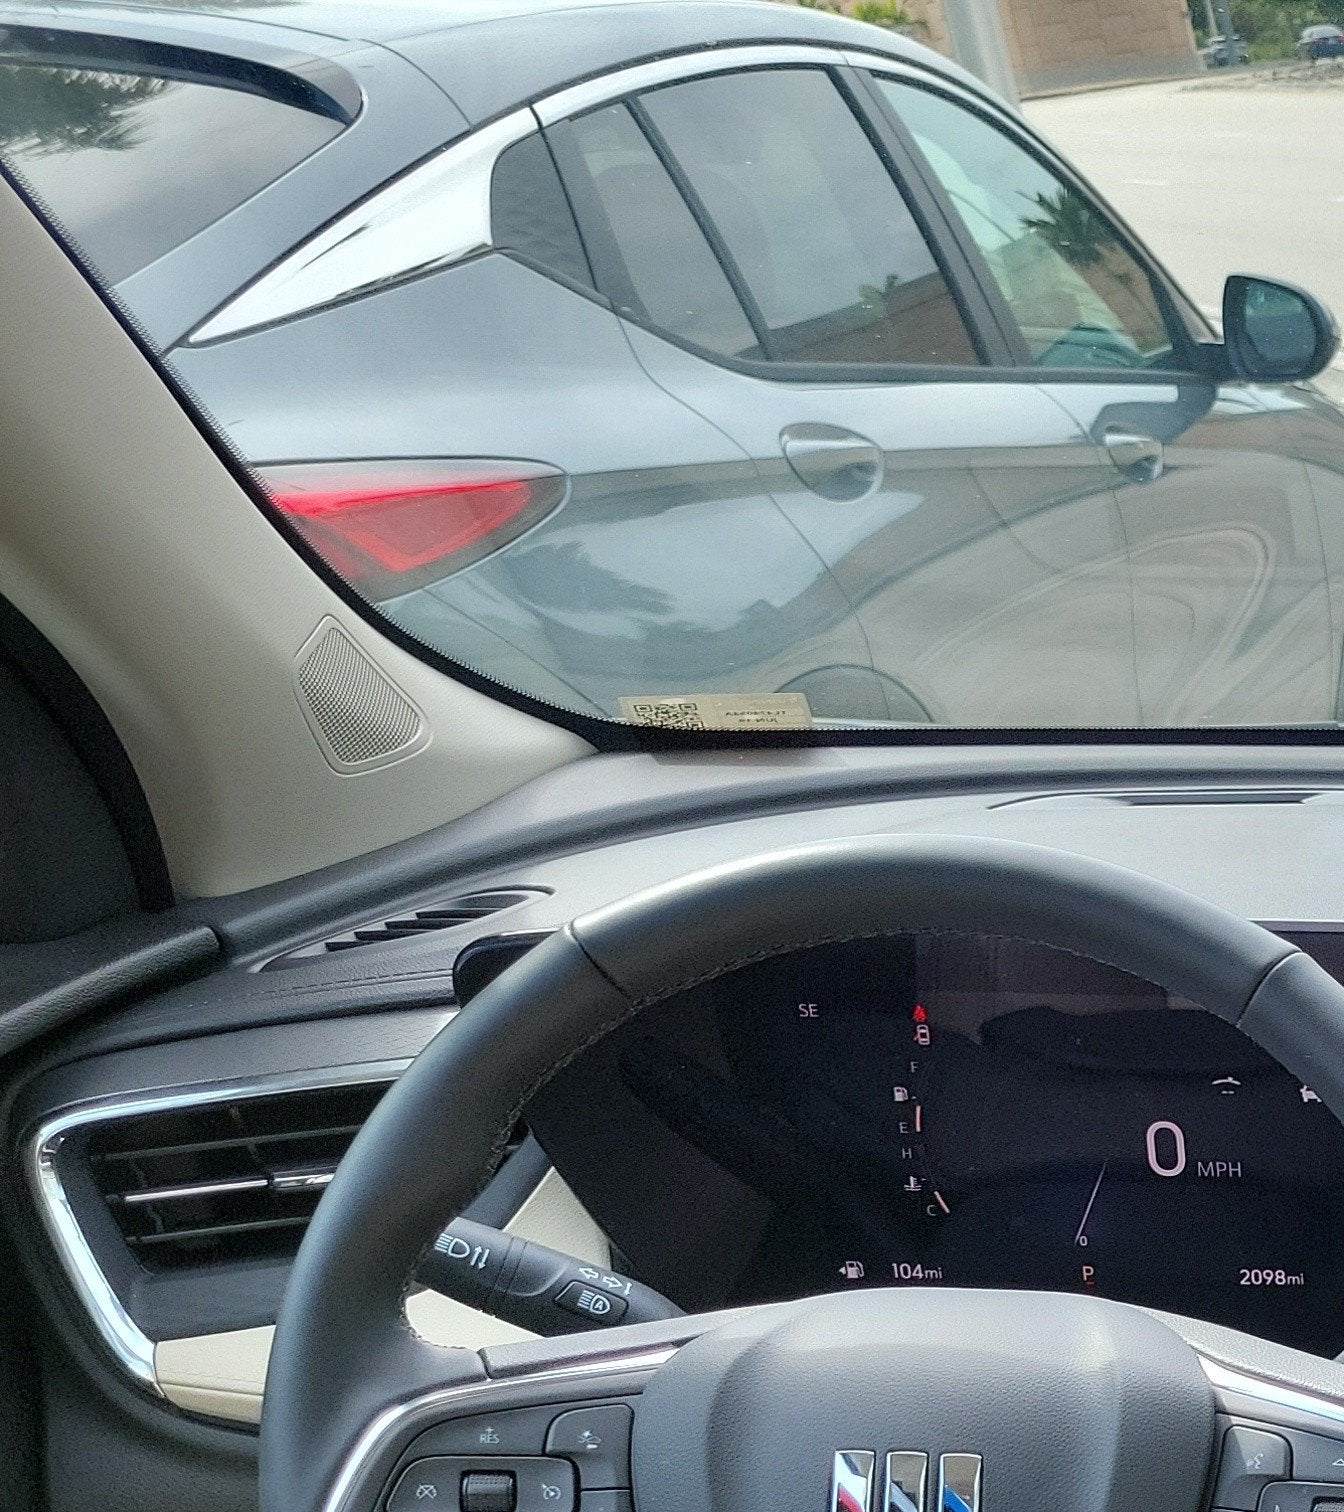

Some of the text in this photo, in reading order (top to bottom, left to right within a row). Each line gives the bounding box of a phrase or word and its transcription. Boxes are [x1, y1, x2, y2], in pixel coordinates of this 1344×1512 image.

[798, 1003, 820, 1018] SE
[910, 1061, 919, 1073] F
[900, 1122, 909, 1134] E
[902, 1148, 912, 1159] H
[1146, 1120, 1186, 1177] 0
[1197, 1161, 1242, 1178] MPH
[926, 1205, 937, 1217] C
[1082, 1266, 1094, 1282] P
[479, 1433, 499, 1444] RES
